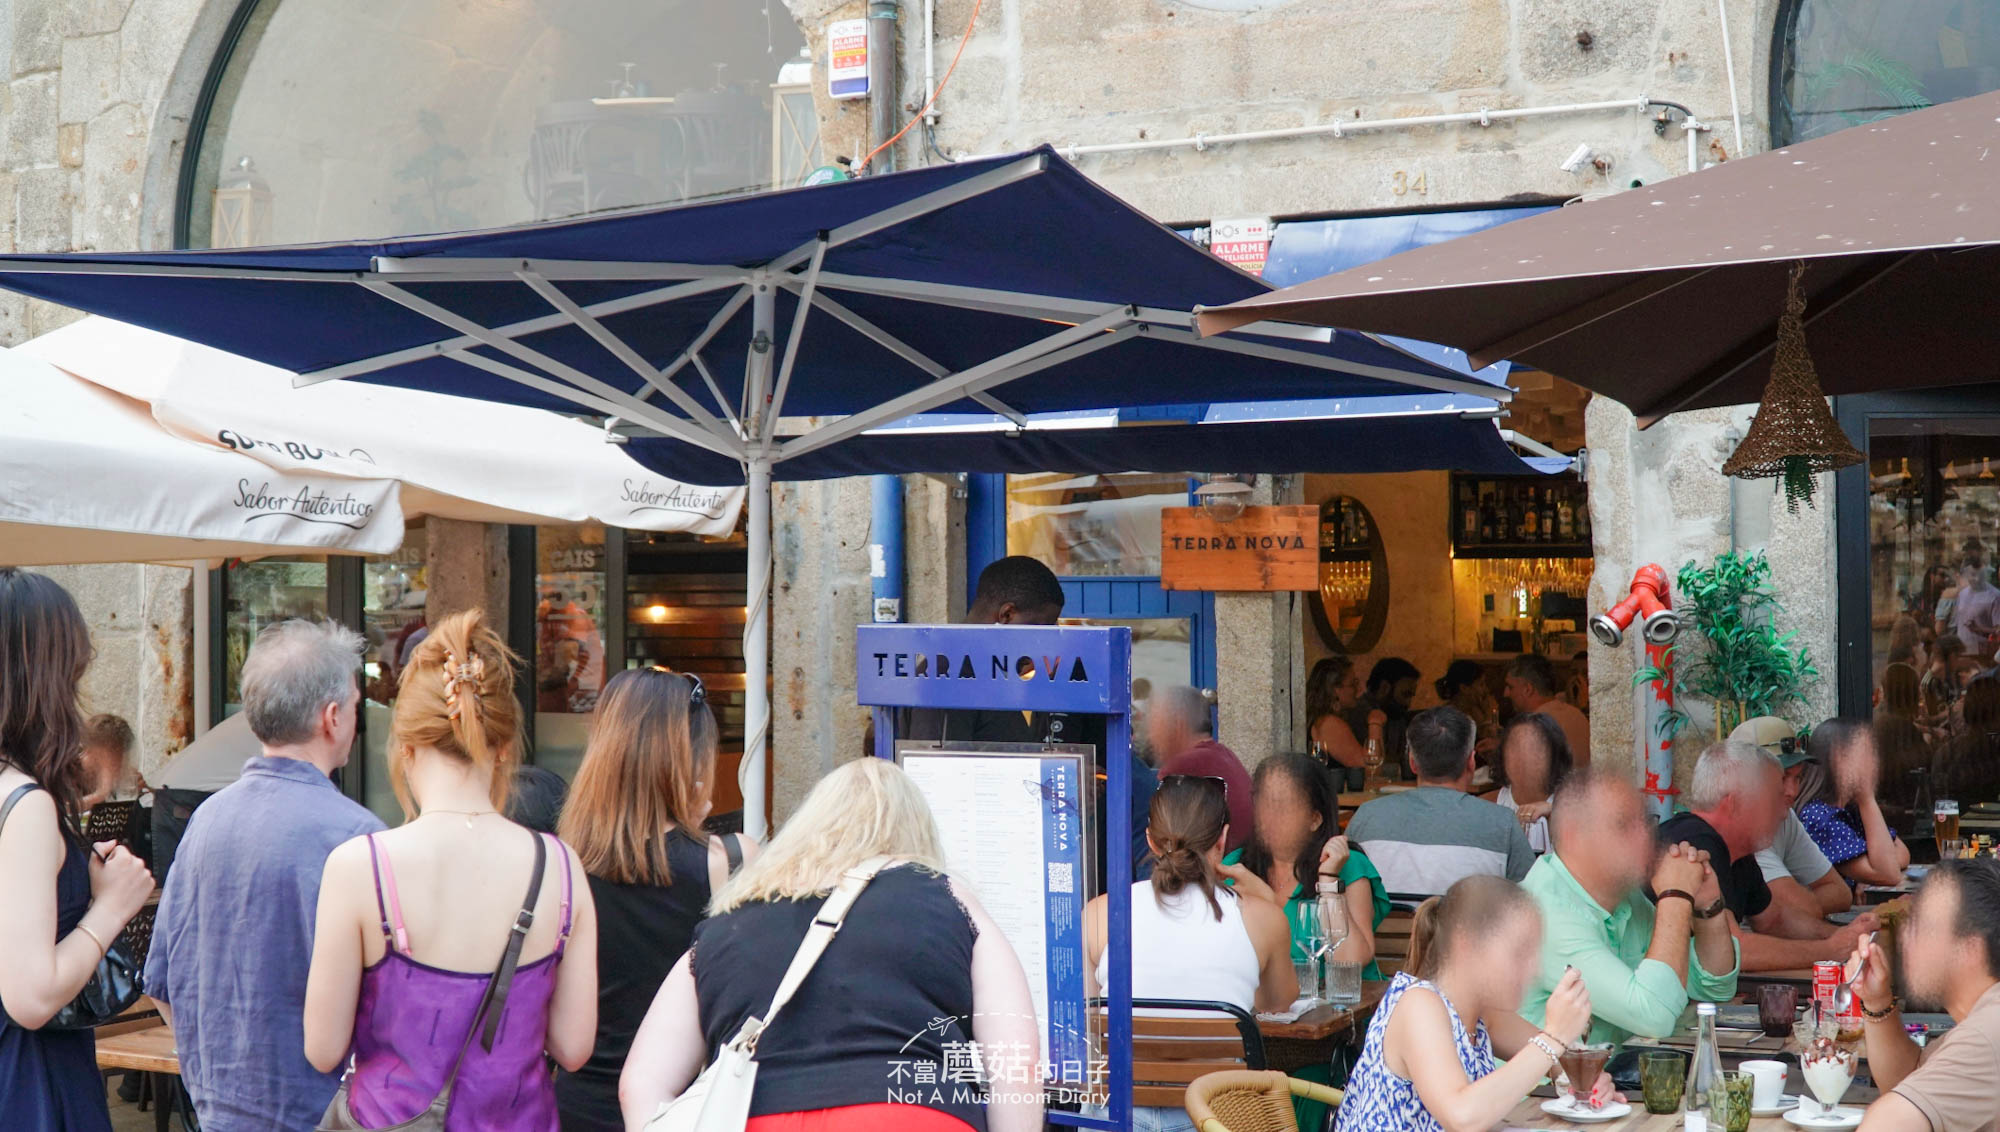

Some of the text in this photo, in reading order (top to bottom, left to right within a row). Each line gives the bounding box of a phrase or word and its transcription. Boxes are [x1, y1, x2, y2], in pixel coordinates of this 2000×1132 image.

[1391, 169, 1428, 197] 34
[1215, 225, 1240, 239] NOS
[1215, 242, 1265, 254] ALARME
[234, 478, 288, 511] Sabor
[620, 478, 662, 505] Sabor
[1172, 536, 1305, 550] TERRA NOVA
[551, 548, 596, 569] CAIS
[873, 652, 1089, 682] TERRA NOVA
[1056, 765, 1069, 851] TERRA NOVA
